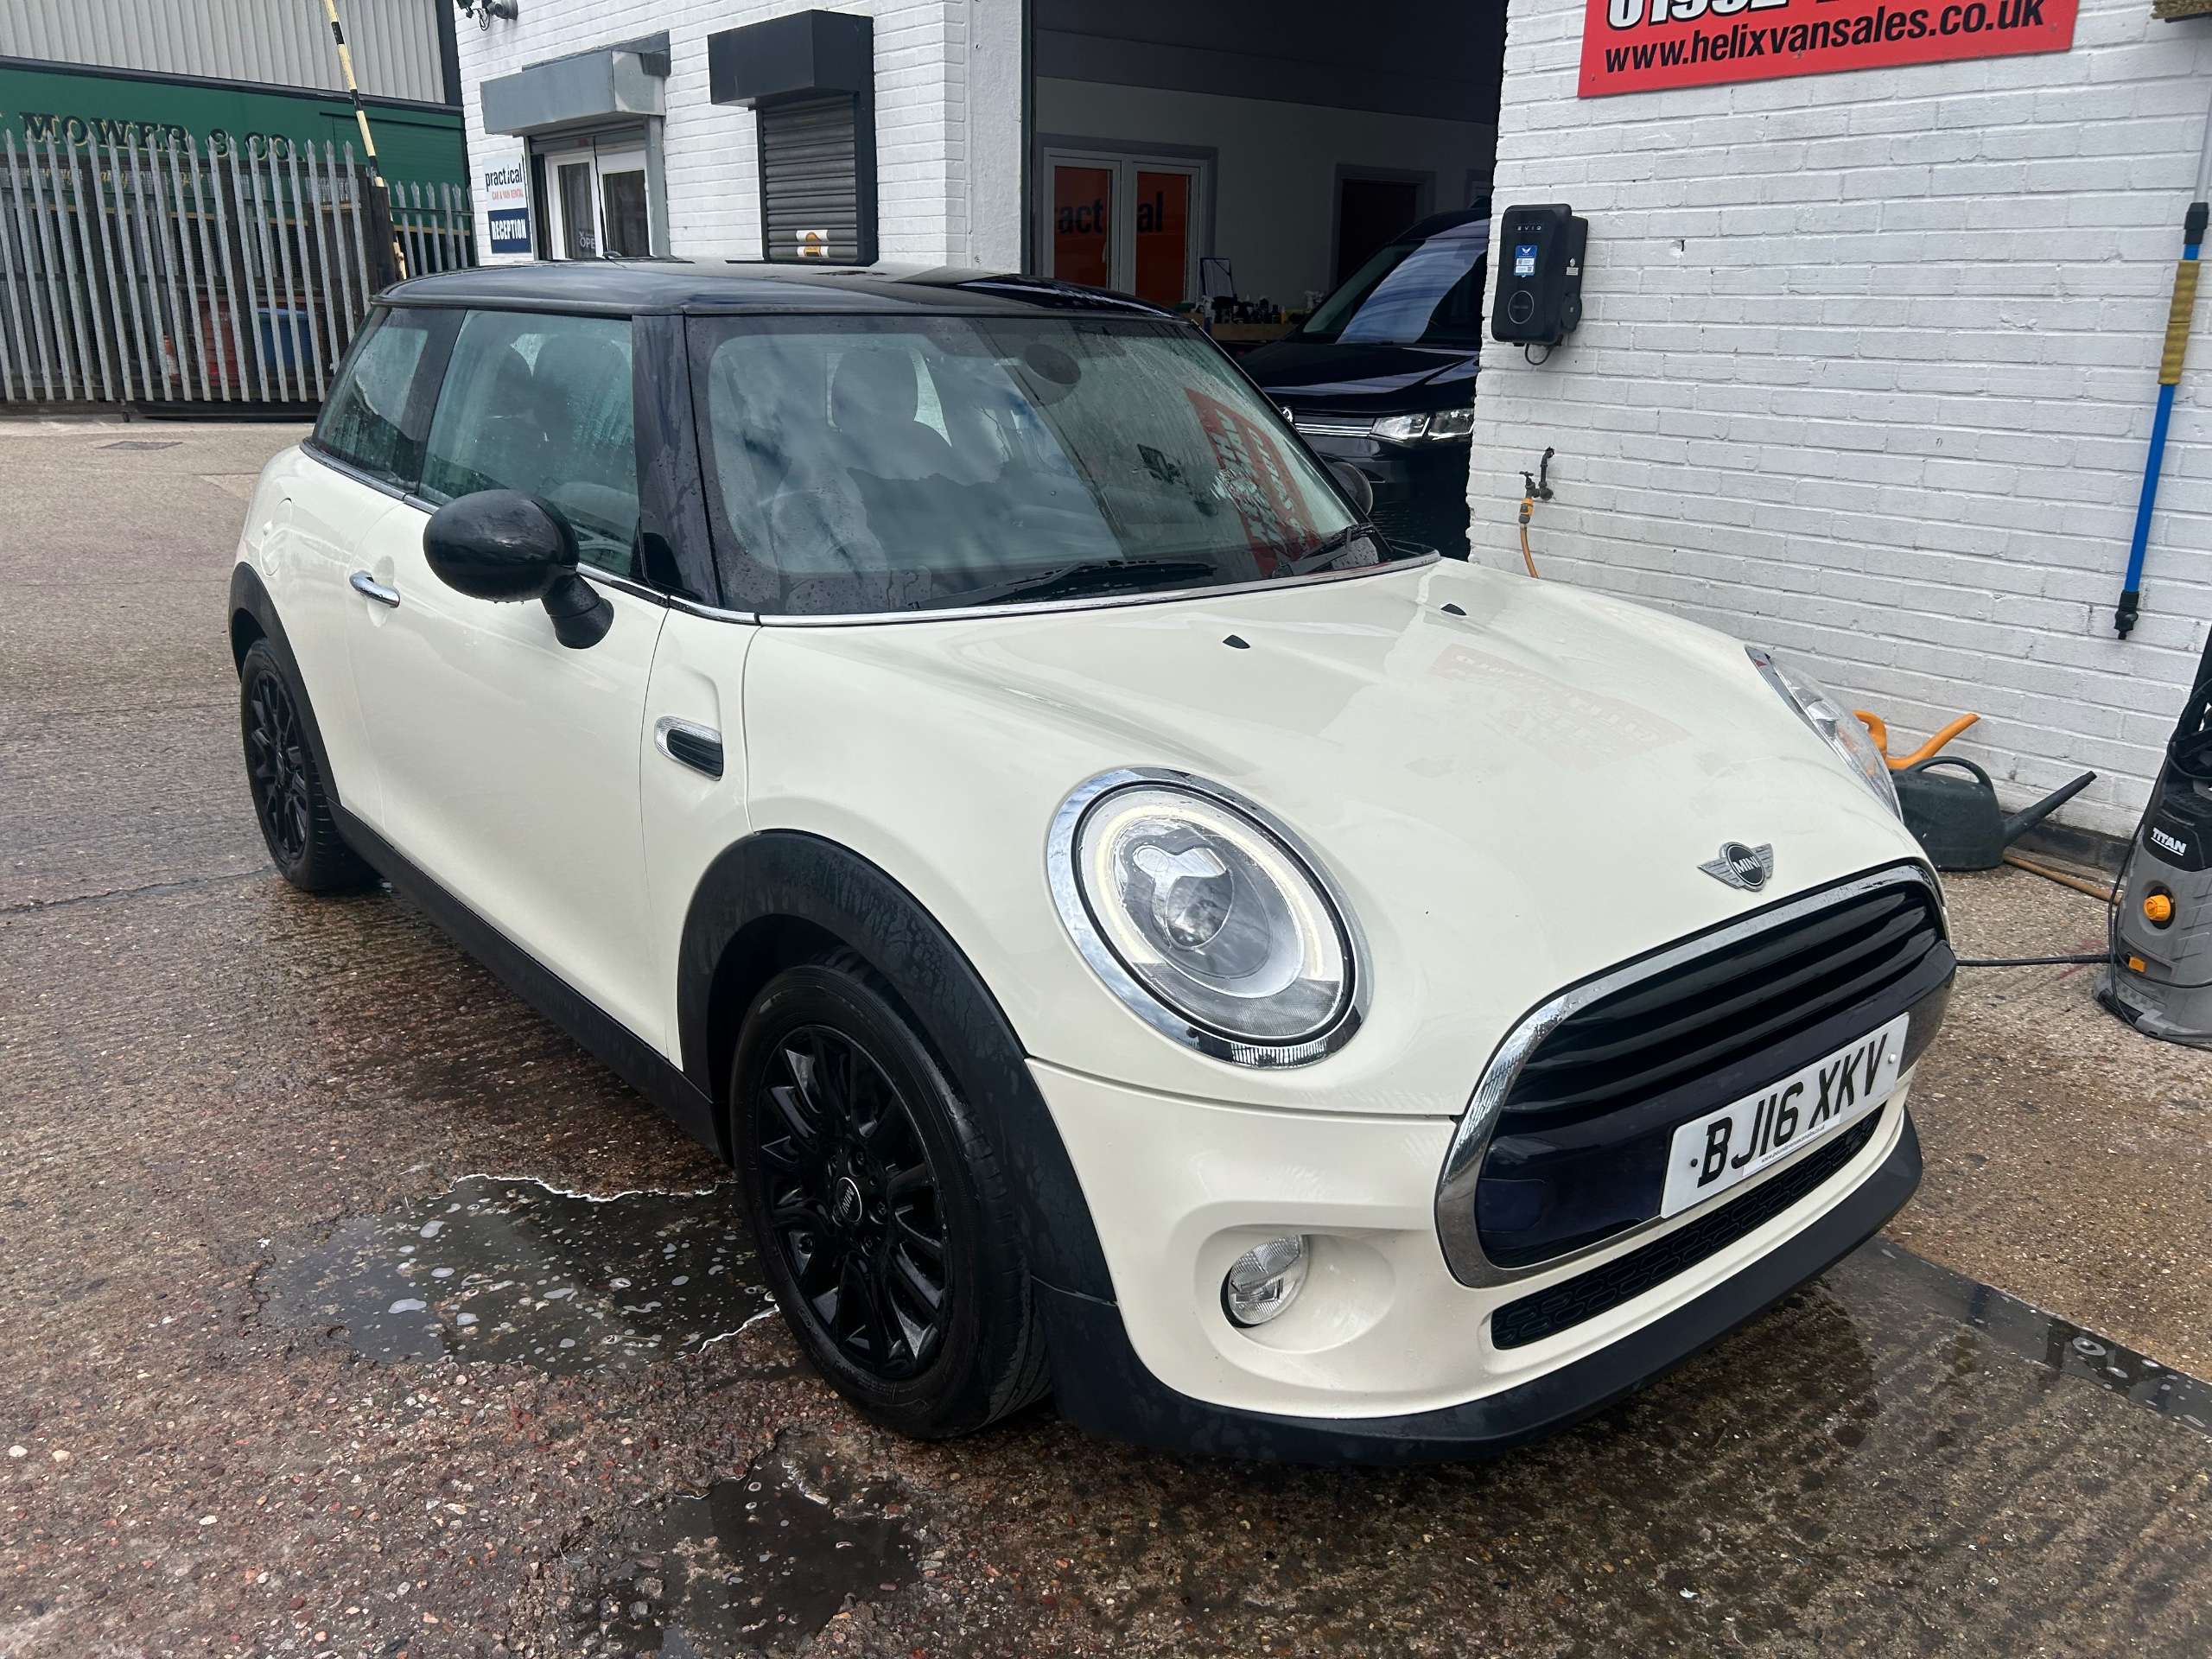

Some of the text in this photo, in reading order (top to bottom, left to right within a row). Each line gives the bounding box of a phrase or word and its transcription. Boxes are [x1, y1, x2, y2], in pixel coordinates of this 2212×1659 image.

[1605, 0, 2044, 73] www.helixvansales.co.uk
[19, 111, 189, 155] MOWER
[485, 162, 523, 192] practical
[491, 219, 527, 240] RECEPTION
[2152, 827, 2187, 854] TITAN
[1732, 855, 1761, 874] MINI
[1697, 1033, 1888, 1188] BJ16 XKV
[842, 1185, 855, 1214] MINI
